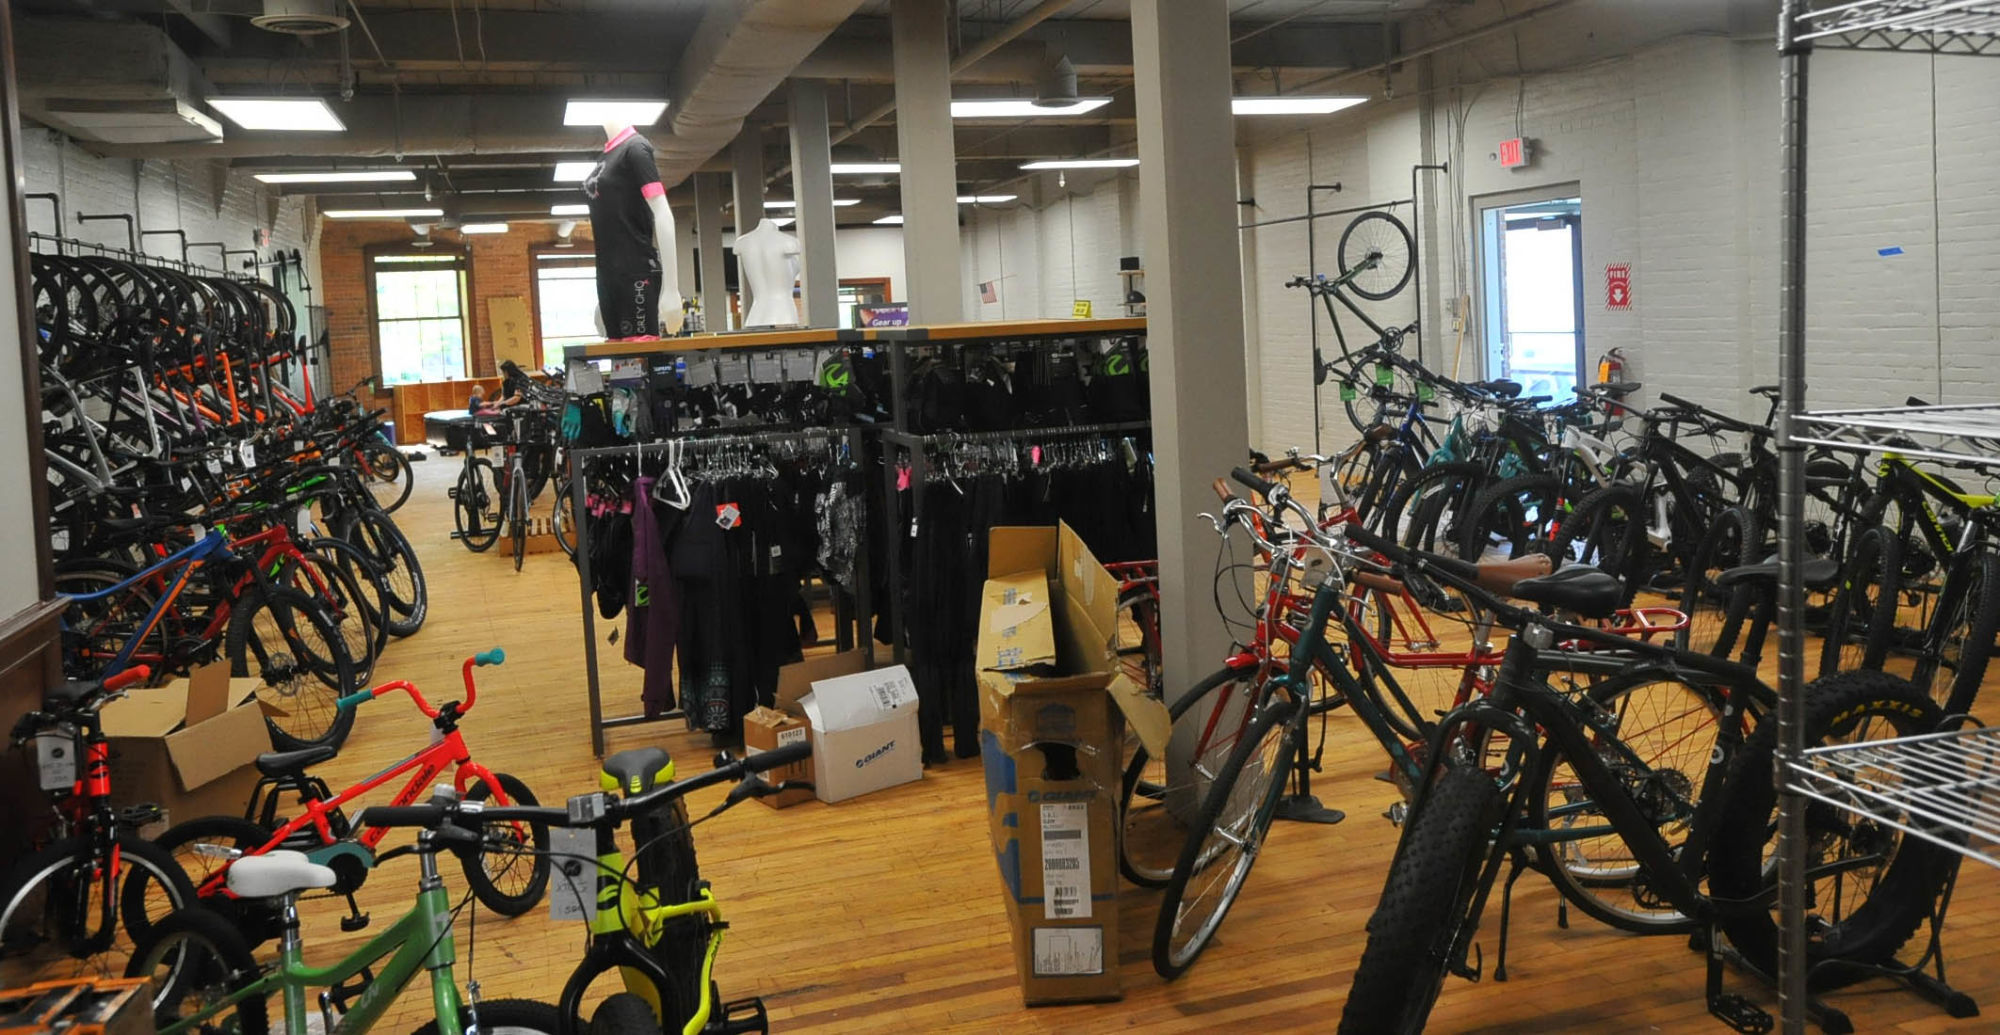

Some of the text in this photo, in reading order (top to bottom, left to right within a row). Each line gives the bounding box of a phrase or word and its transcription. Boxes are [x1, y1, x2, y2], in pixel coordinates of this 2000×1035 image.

[1500, 140, 1521, 165] EXIT
[1609, 269, 1627, 279] FIRE
[872, 319, 902, 328] Gear up
[1830, 699, 1924, 728] MAXXIS
[863, 740, 896, 764] GIANT
